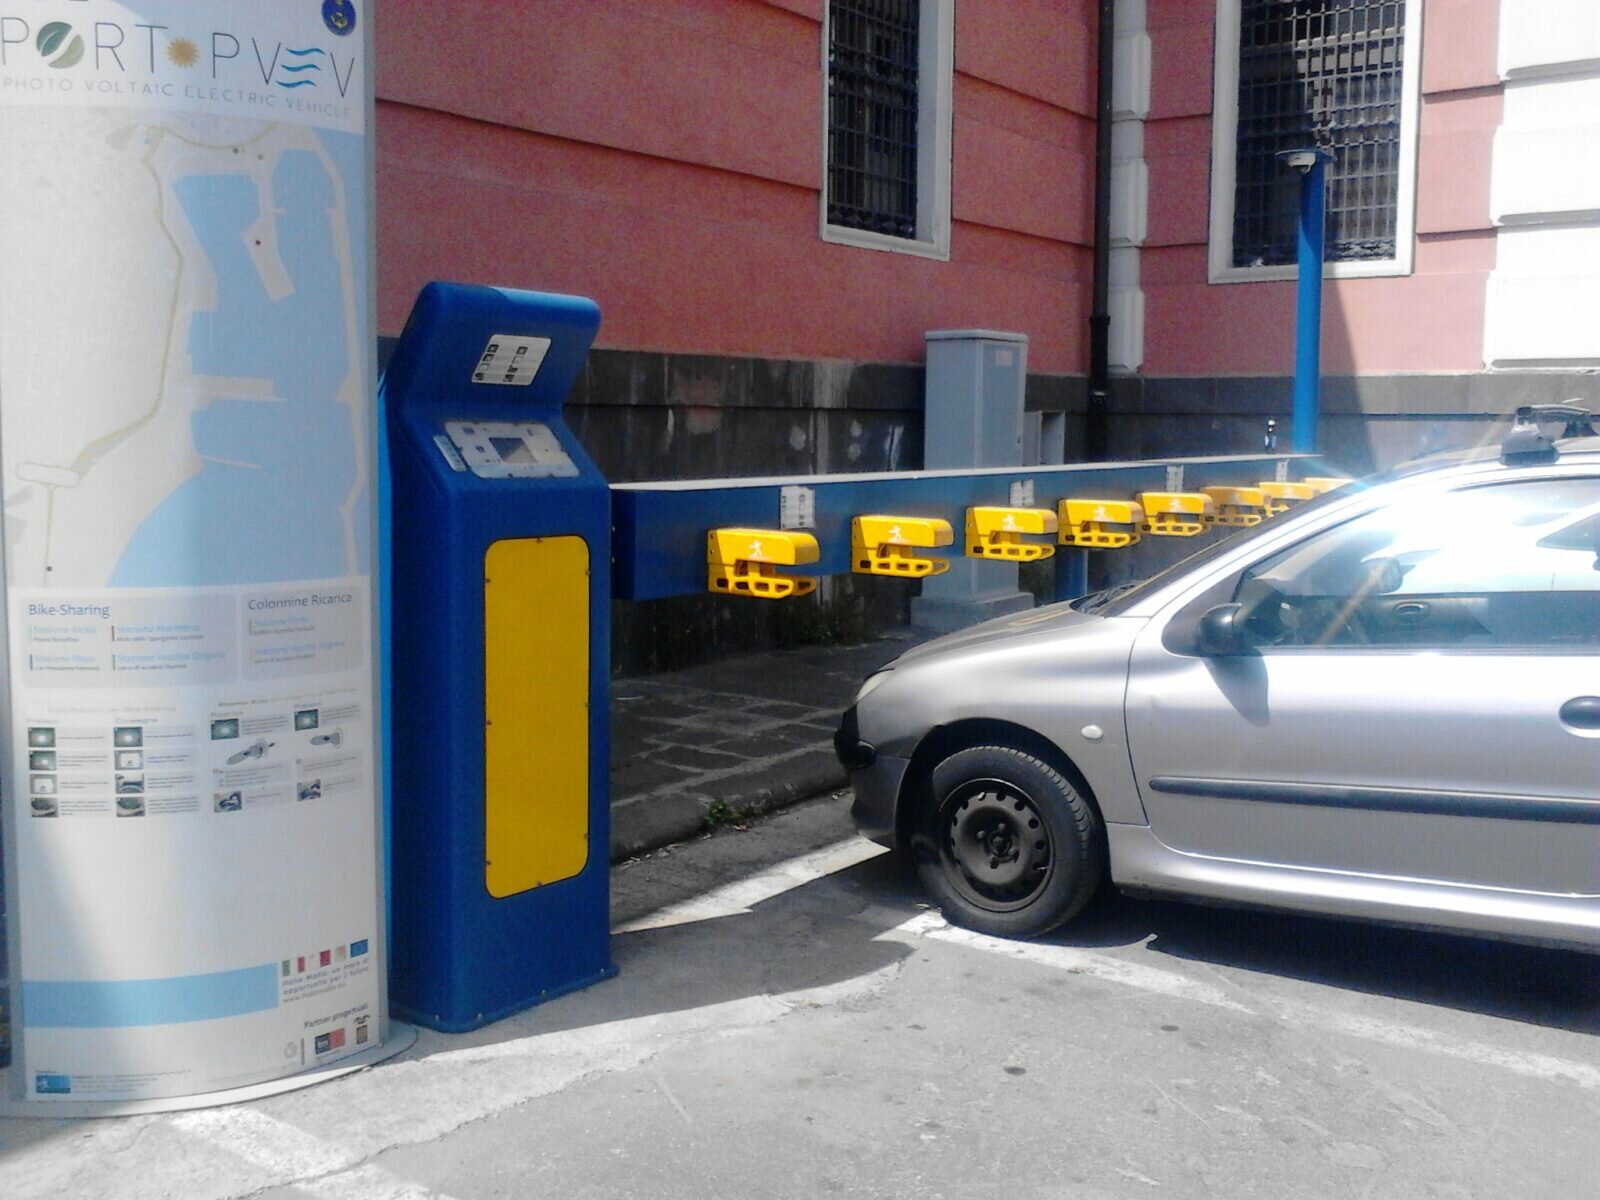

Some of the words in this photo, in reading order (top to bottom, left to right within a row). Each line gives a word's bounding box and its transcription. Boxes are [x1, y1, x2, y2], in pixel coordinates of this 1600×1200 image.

[3, 77, 73, 92] PHOTO
[84, 80, 175, 97] VOLTAIC
[185, 85, 275, 107] ELECTRIC
[286, 97, 350, 119] VEHICLE
[248, 597, 309, 610] Colonnine
[311, 594, 353, 605] Ricarica
[28, 603, 110, 619] Bike-Sharing
